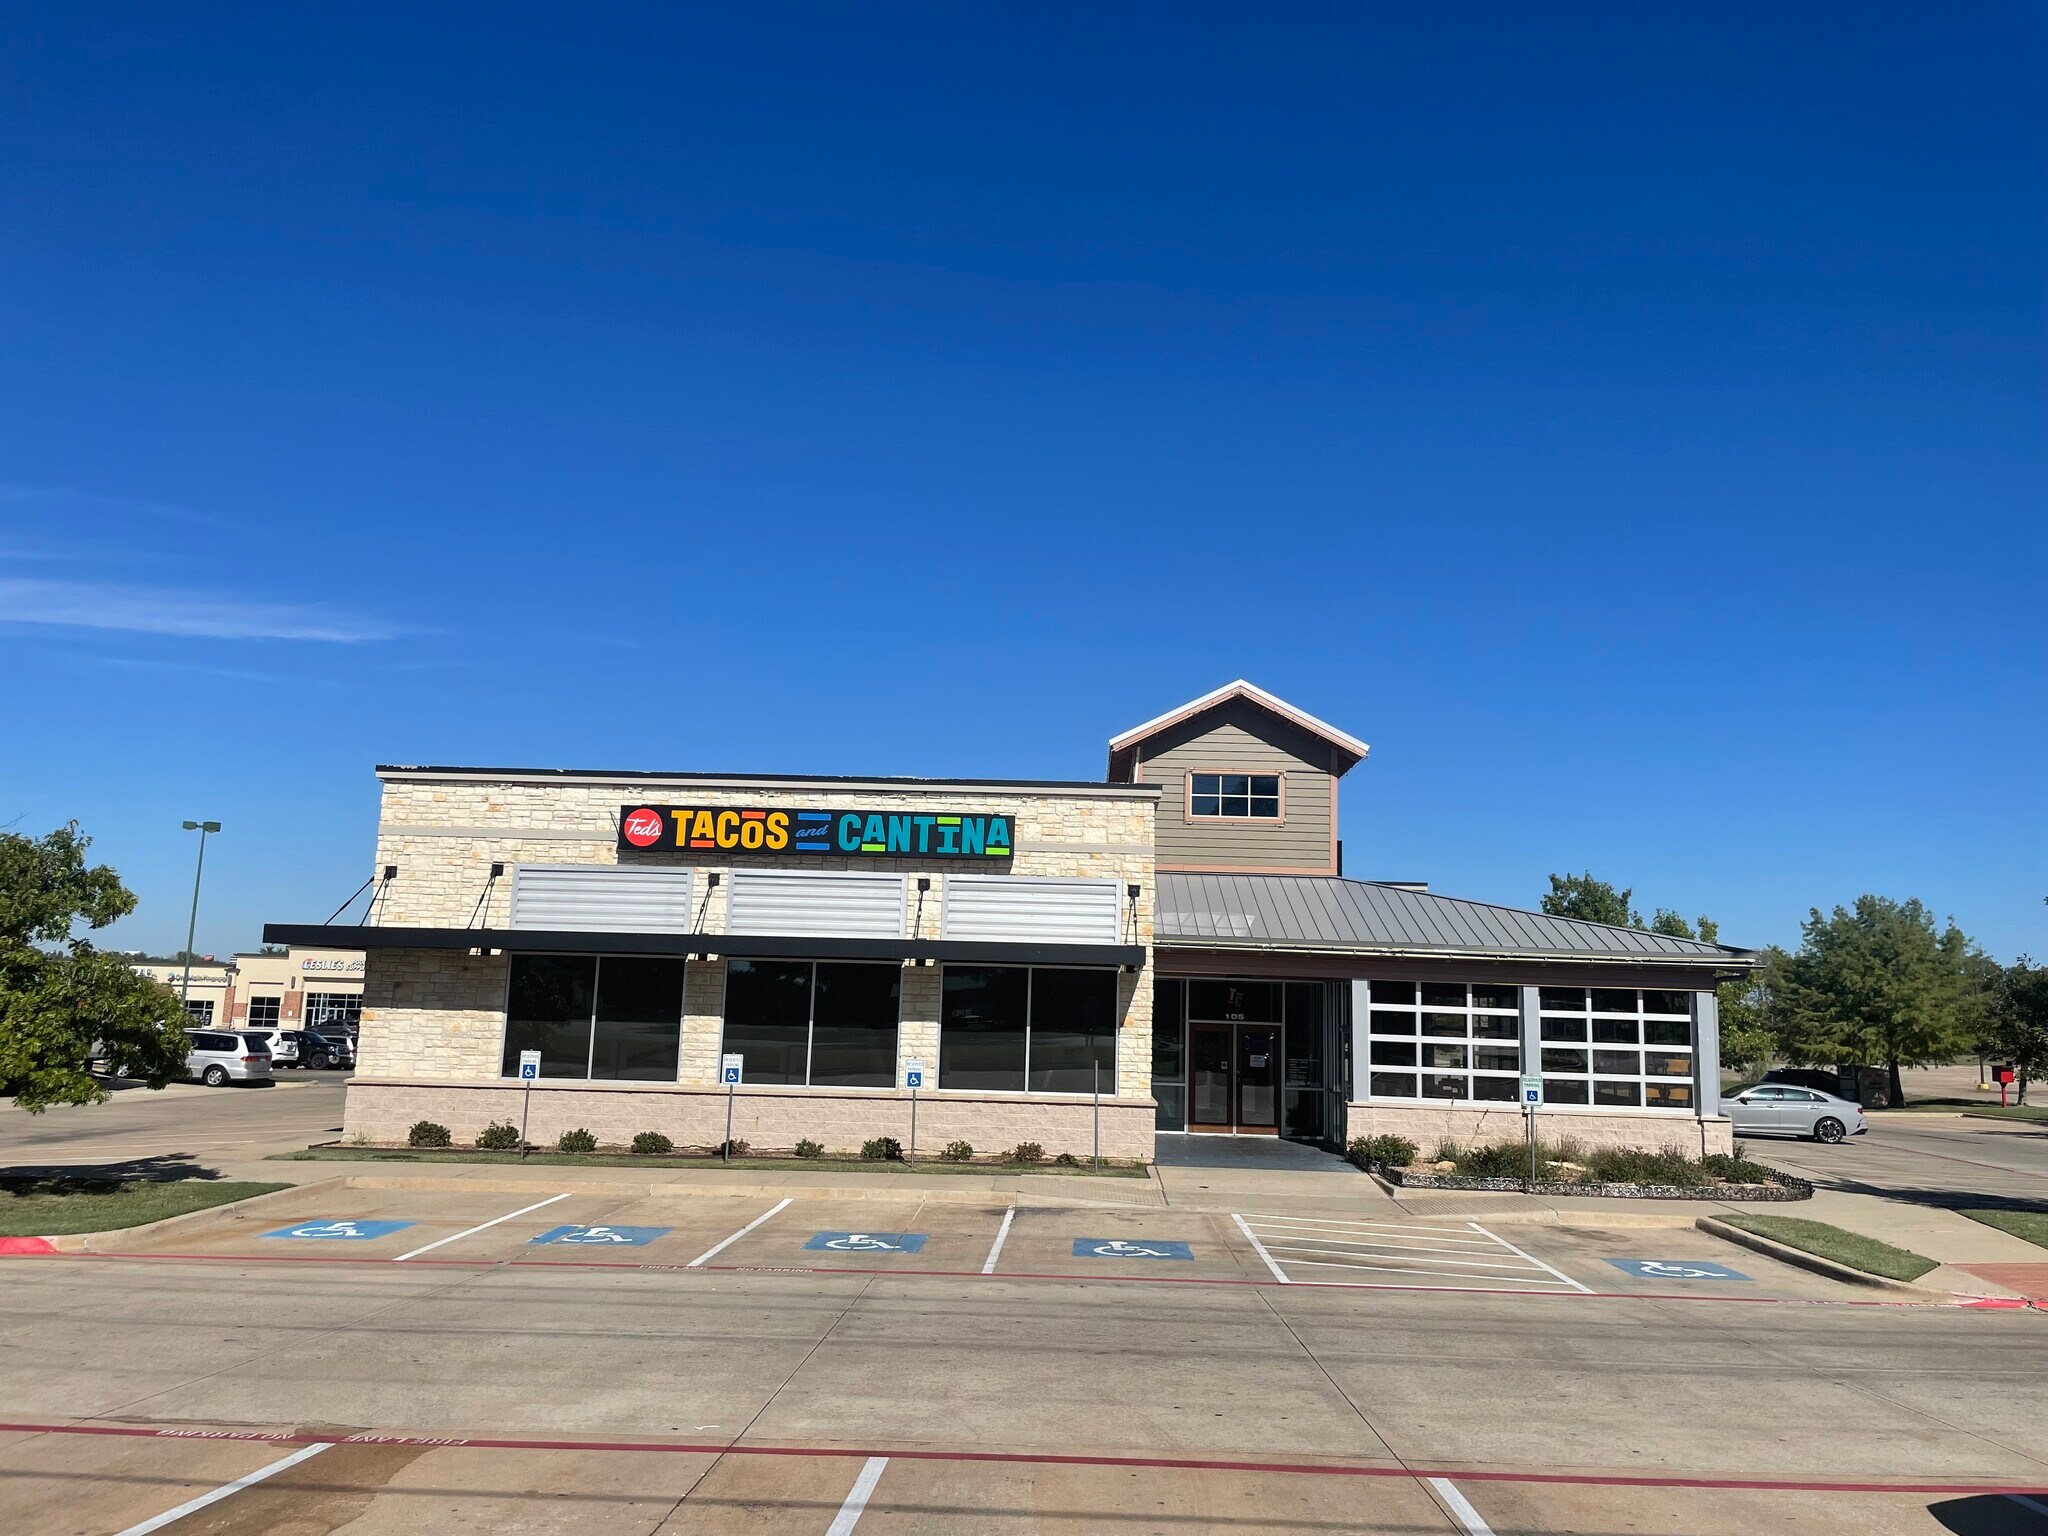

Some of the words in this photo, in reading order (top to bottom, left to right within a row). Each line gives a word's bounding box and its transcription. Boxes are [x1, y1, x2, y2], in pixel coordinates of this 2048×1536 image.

[626, 818, 662, 836] Ted's
[795, 825, 828, 838] and
[838, 813, 1010, 855] CANTINA
[302, 958, 345, 971] LESLIE'S
